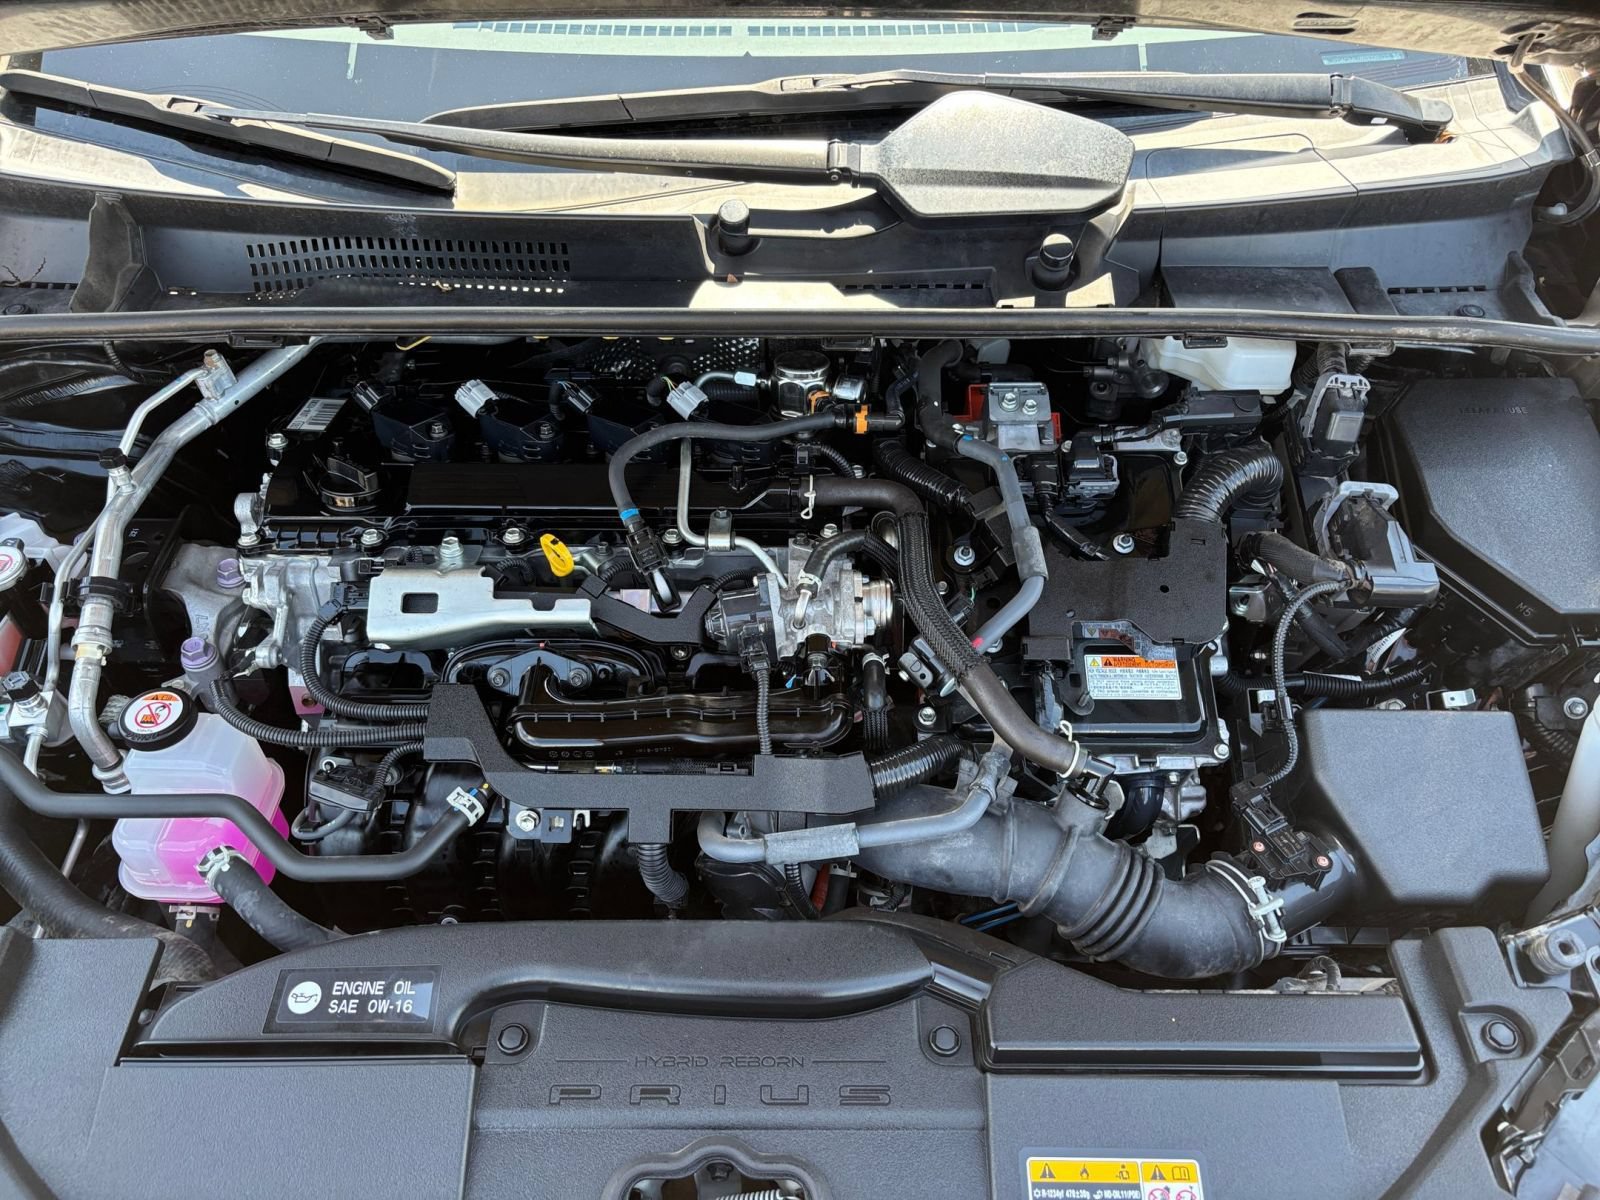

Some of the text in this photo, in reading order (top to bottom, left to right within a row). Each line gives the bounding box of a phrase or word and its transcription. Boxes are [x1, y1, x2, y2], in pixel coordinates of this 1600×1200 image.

[332, 980, 416, 996] ENGINE OIL
[328, 999, 414, 1014] SAE 0W-16
[635, 1056, 805, 1068] HYBRID REBORN
[548, 1083, 892, 1107] PRIUS
